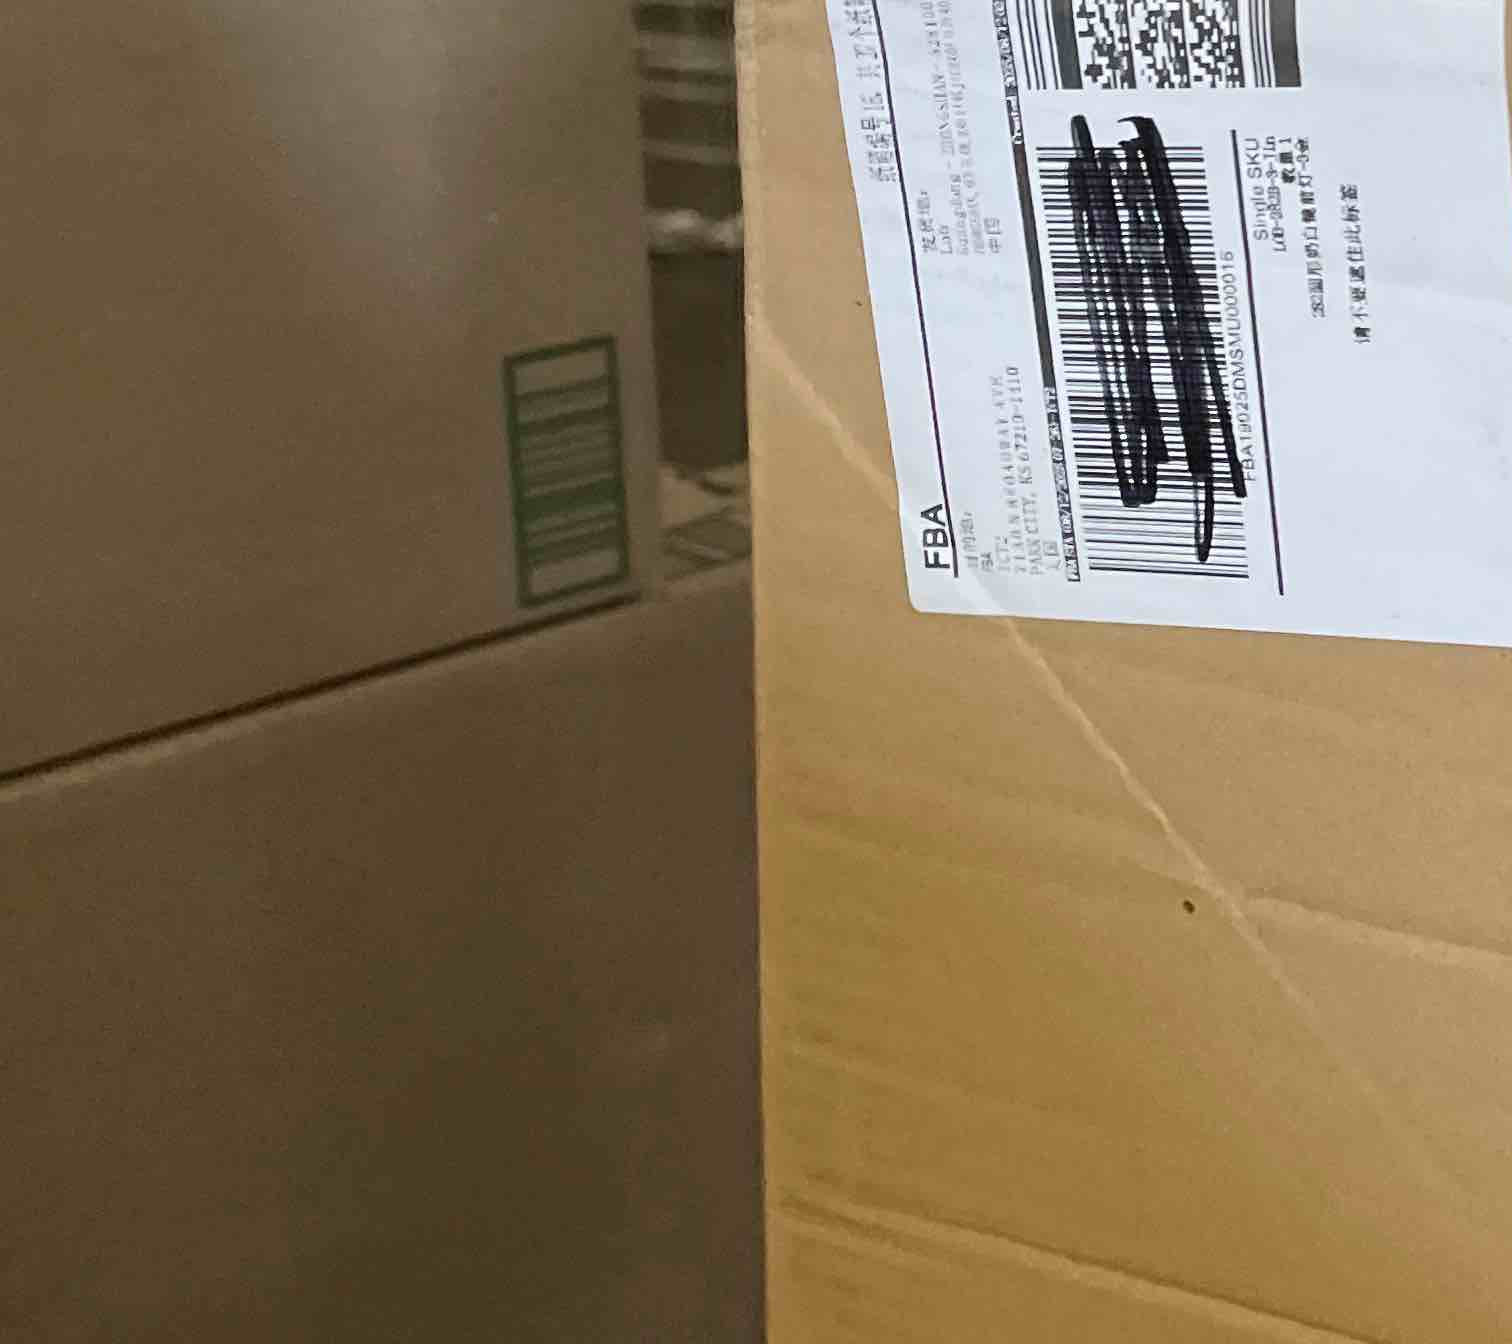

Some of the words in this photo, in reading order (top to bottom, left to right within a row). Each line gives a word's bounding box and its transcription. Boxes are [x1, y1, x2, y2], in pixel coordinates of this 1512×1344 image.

[1245, 137, 1263, 179] SKU
[1252, 186, 1270, 241] Single
[920, 504, 950, 569] FBA
